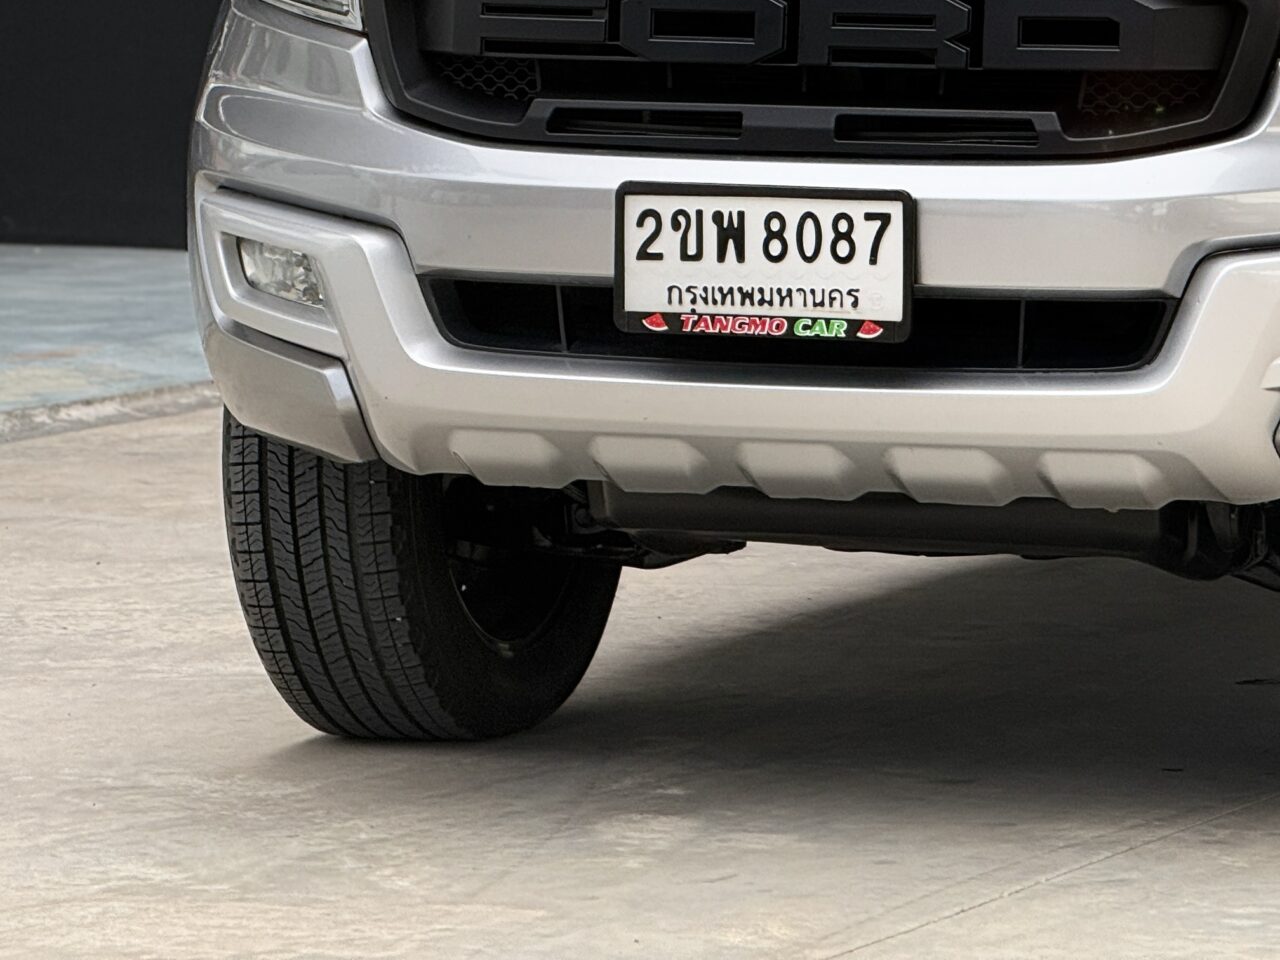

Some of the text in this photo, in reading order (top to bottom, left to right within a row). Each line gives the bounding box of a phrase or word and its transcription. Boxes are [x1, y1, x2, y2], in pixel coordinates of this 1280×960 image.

[635, 208, 892, 265] 2ขพ 8087
[667, 284, 860, 312] กรุงเทพมหานคร
[680, 314, 848, 338] TANGMO CAR
